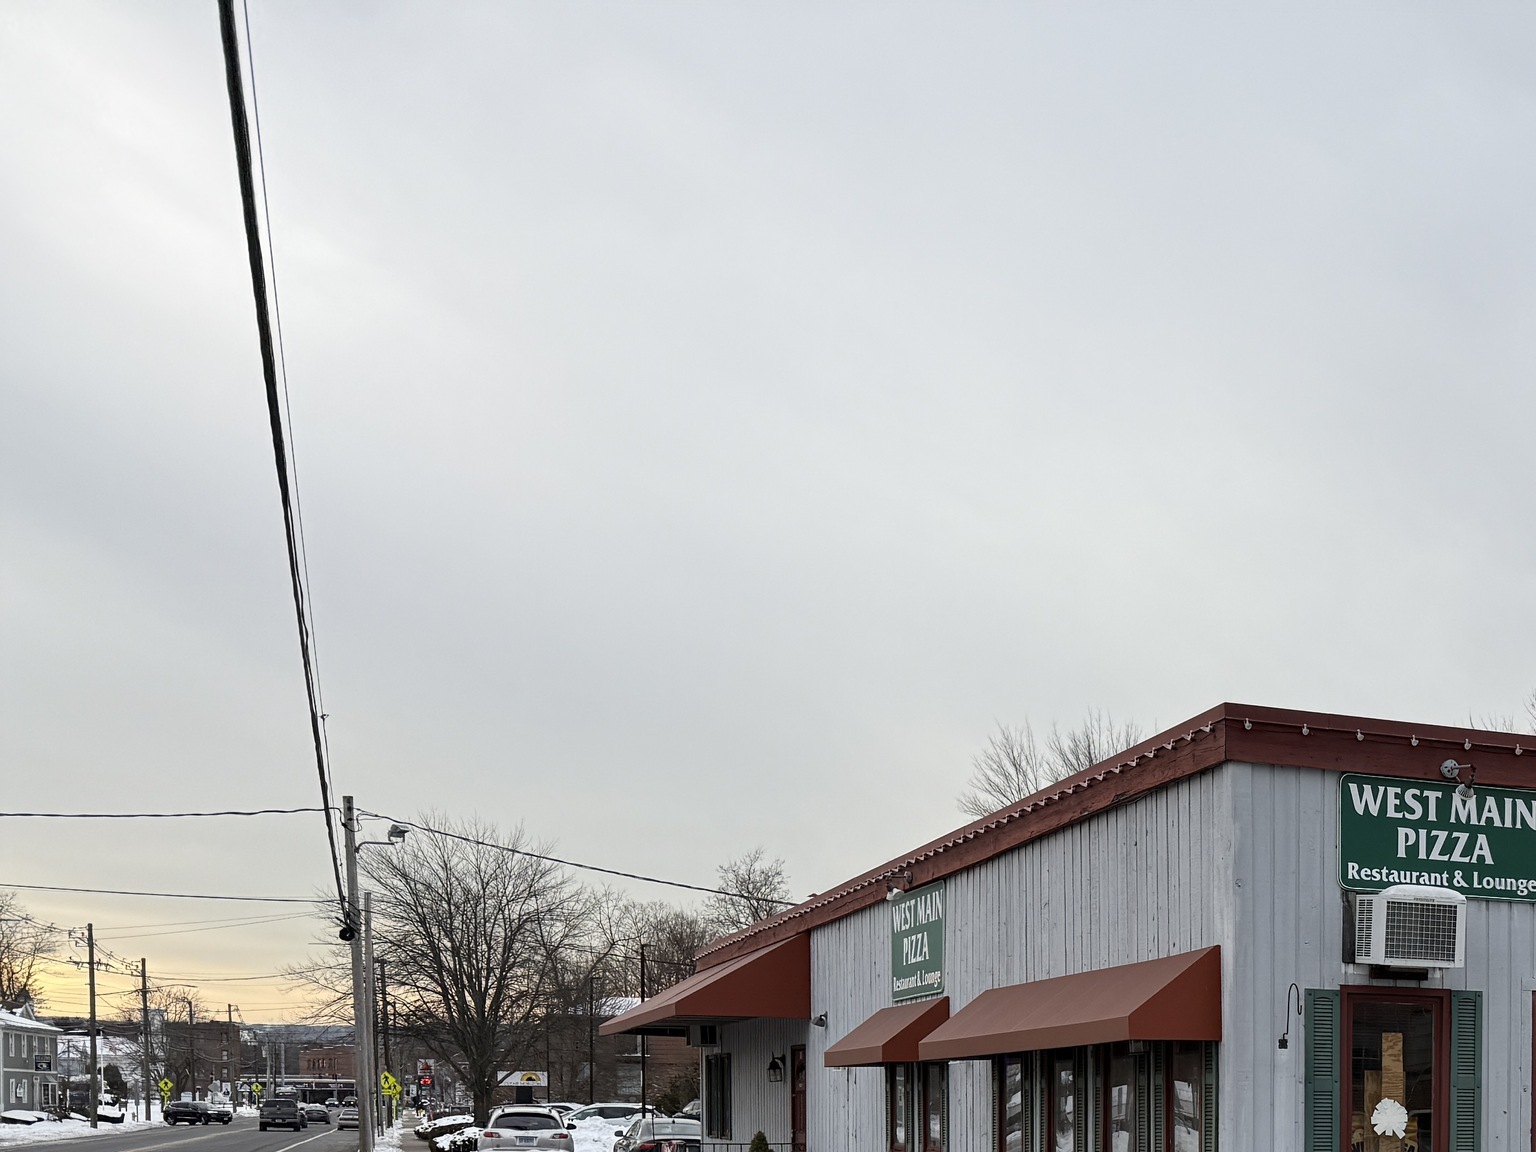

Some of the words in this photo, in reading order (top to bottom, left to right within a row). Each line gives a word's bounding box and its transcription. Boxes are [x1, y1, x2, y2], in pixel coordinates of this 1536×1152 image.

[1348, 783, 1442, 821] WEST
[1396, 827, 1494, 865] PIZZA
[1347, 862, 1449, 887] Restaurant
[1452, 870, 1469, 888] &
[892, 898, 915, 933] WEST
[916, 889, 943, 926] MAIN
[903, 932, 929, 965] PIZZA
